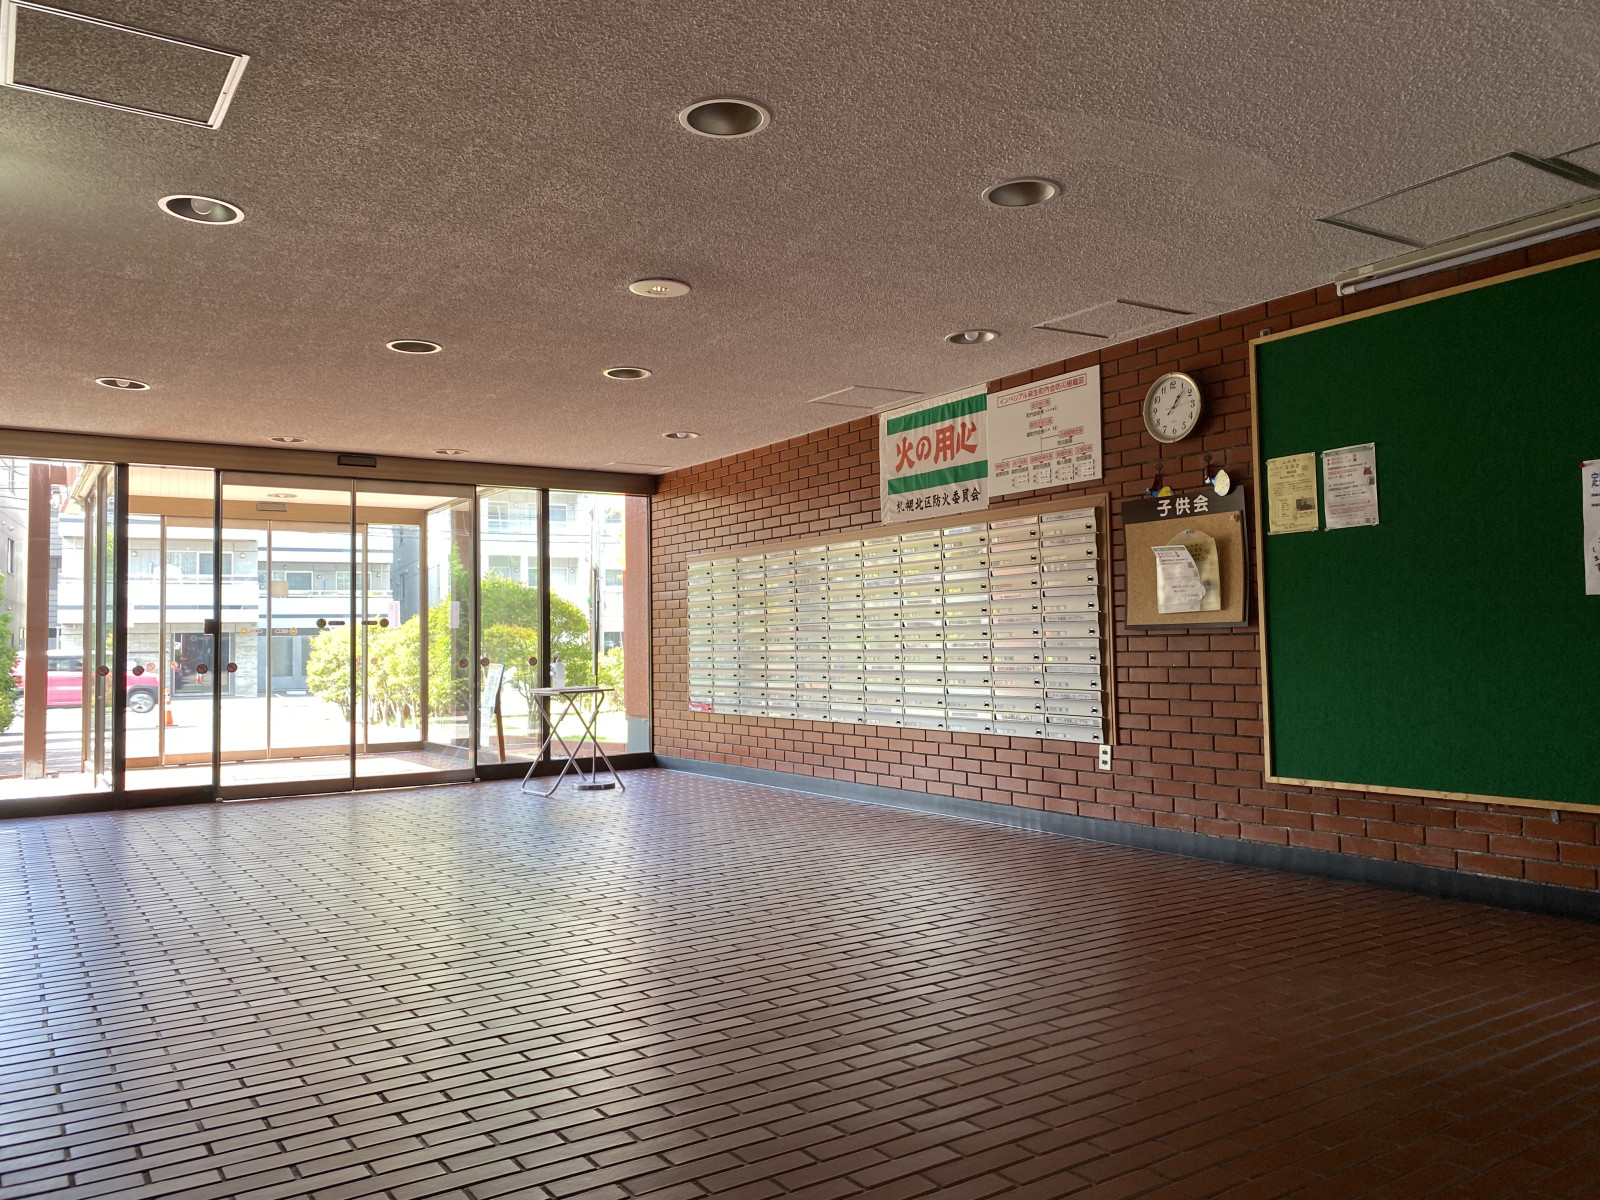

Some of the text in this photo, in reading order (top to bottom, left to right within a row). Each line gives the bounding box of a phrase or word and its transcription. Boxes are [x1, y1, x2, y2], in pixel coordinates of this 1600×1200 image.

[1170, 381, 1176, 389] 12
[1161, 386, 1166, 395] 11
[1187, 388, 1193, 397] 2
[1154, 396, 1161, 404] 10
[1190, 399, 1196, 408] 3
[1153, 407, 1158, 415] 9
[1188, 411, 1193, 420] 4
[1156, 419, 1161, 427] 8
[1182, 421, 1187, 430] 5
[1163, 425, 1167, 434] 7
[1172, 426, 1177, 435] 6
[895, 421, 978, 474] 火の用心
[896, 486, 980, 513] 札幌北区防火委員会
[1157, 494, 1209, 517] 子供会
